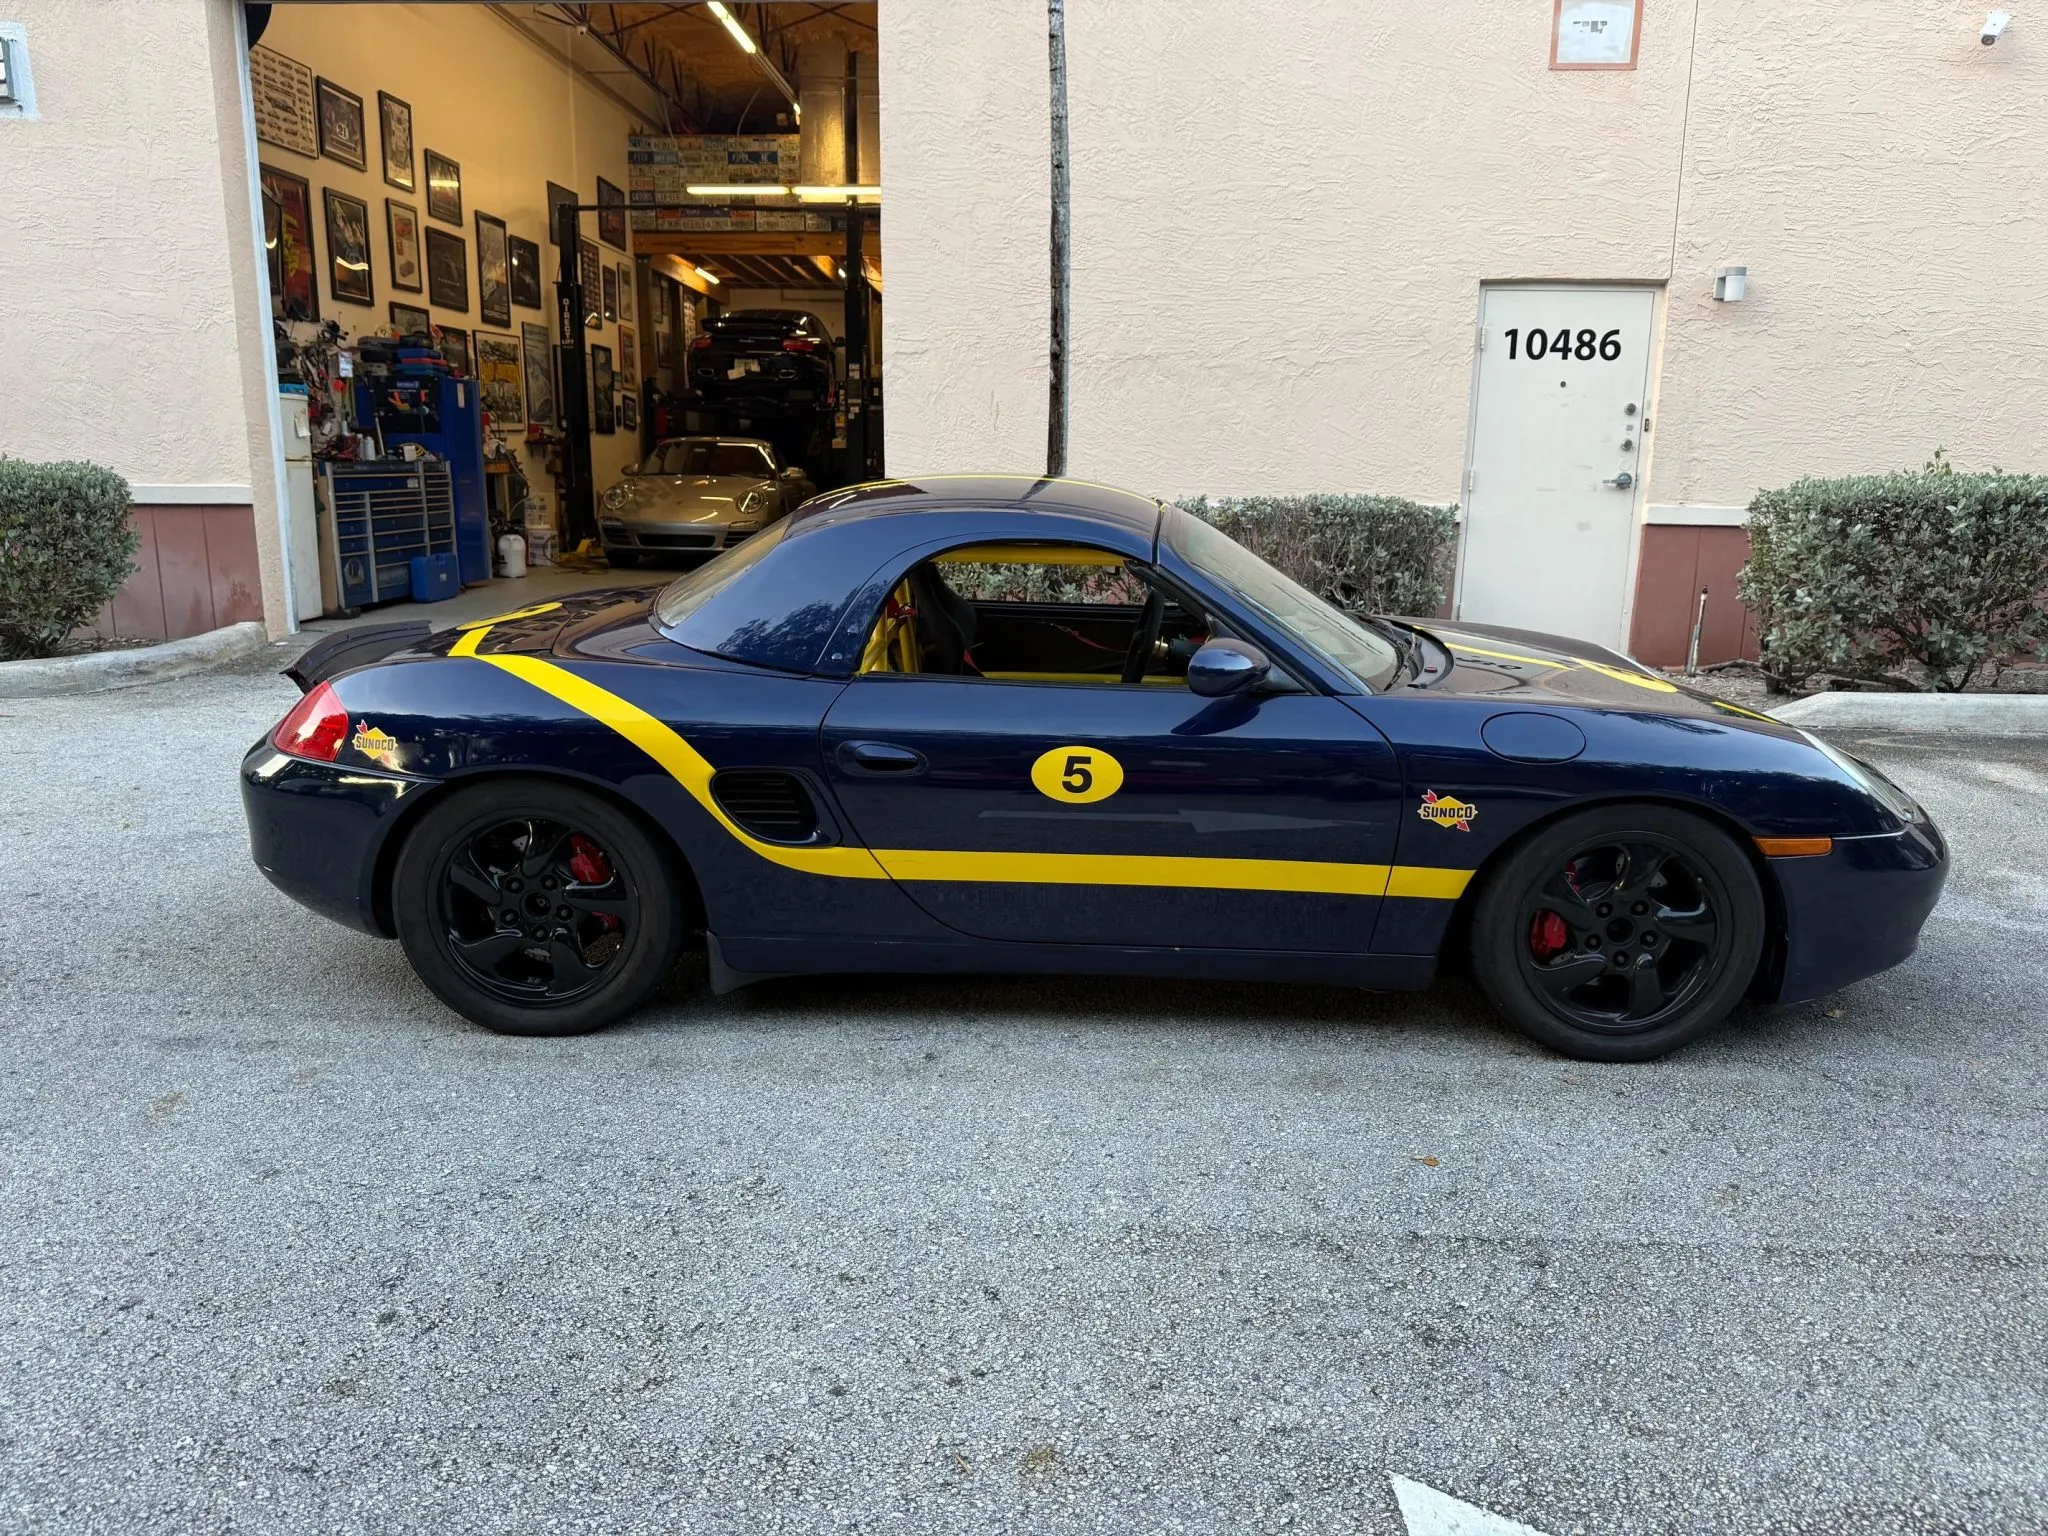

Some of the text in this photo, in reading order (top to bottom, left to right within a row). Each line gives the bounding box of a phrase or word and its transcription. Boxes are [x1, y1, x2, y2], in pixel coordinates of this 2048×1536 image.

[1504, 328, 1622, 361] 10486
[356, 736, 395, 751] SUNOCO
[1061, 755, 1093, 794] 5
[1422, 806, 1473, 819] SUNOCO
